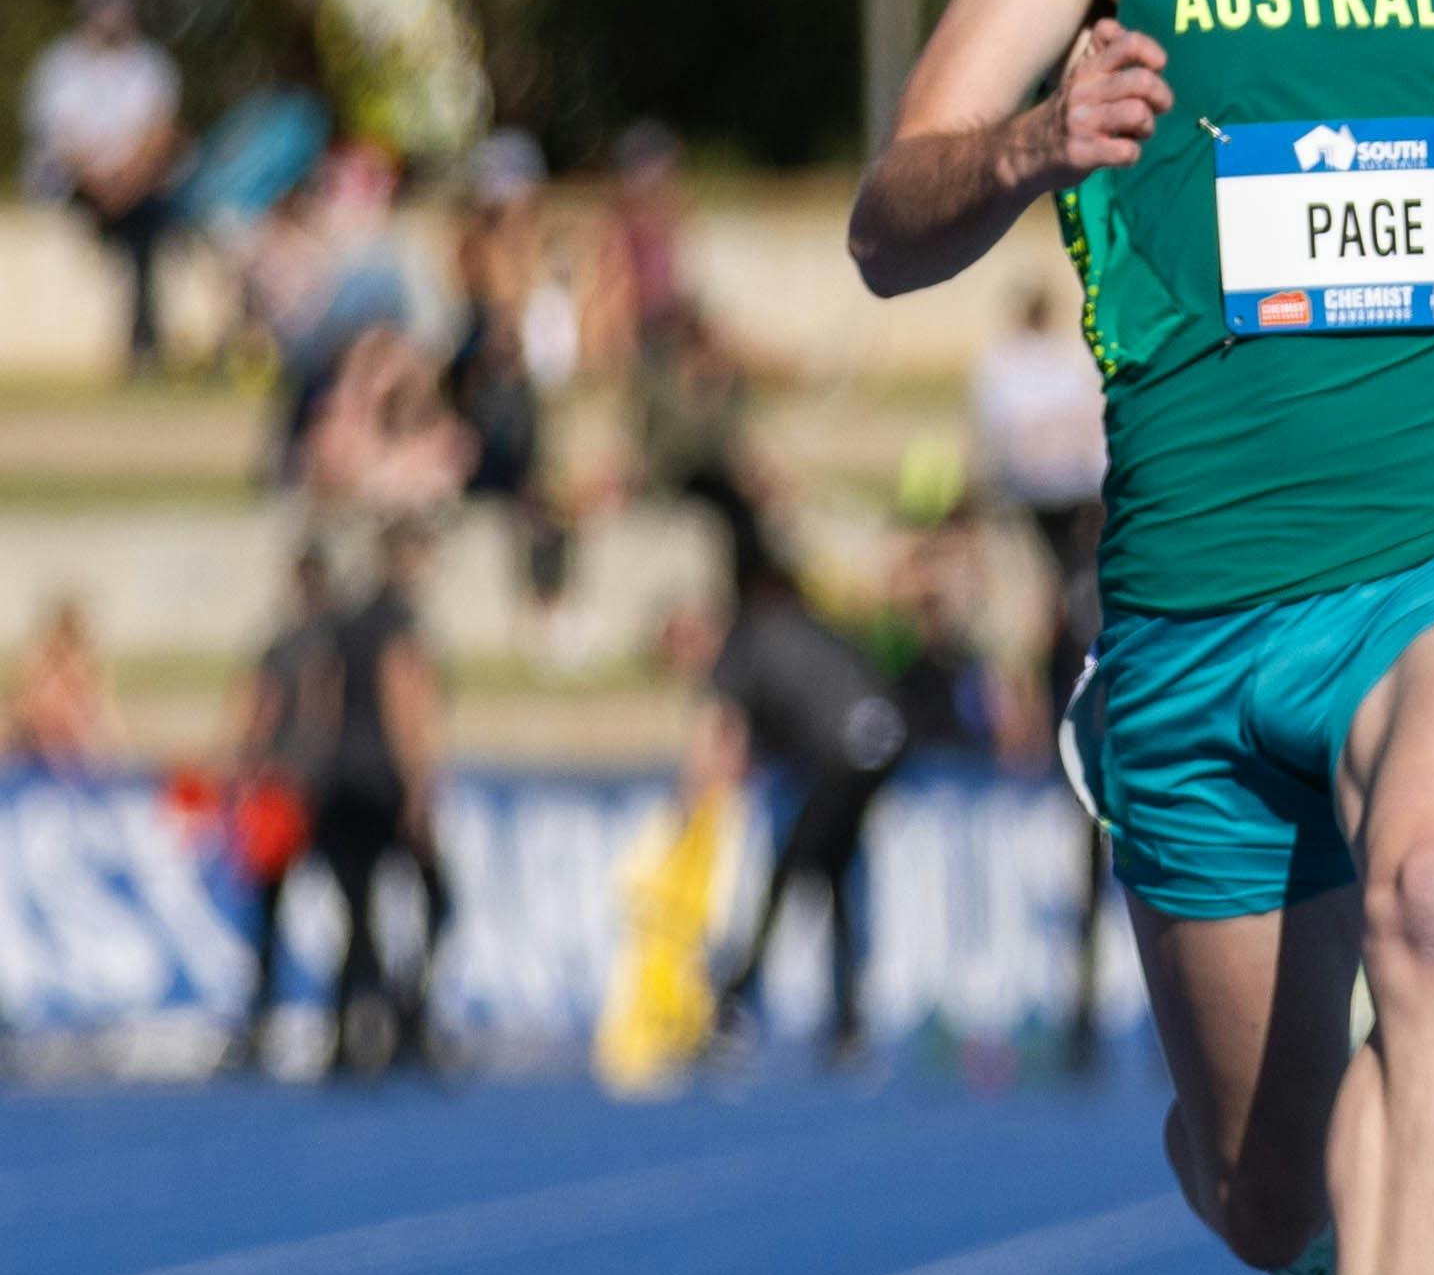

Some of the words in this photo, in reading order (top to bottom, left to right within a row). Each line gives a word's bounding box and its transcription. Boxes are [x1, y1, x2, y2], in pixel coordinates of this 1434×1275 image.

[1357, 139, 1428, 161] SOUTH
[1306, 198, 1425, 259] PAGE
[1324, 285, 1414, 309] CHEMIST
